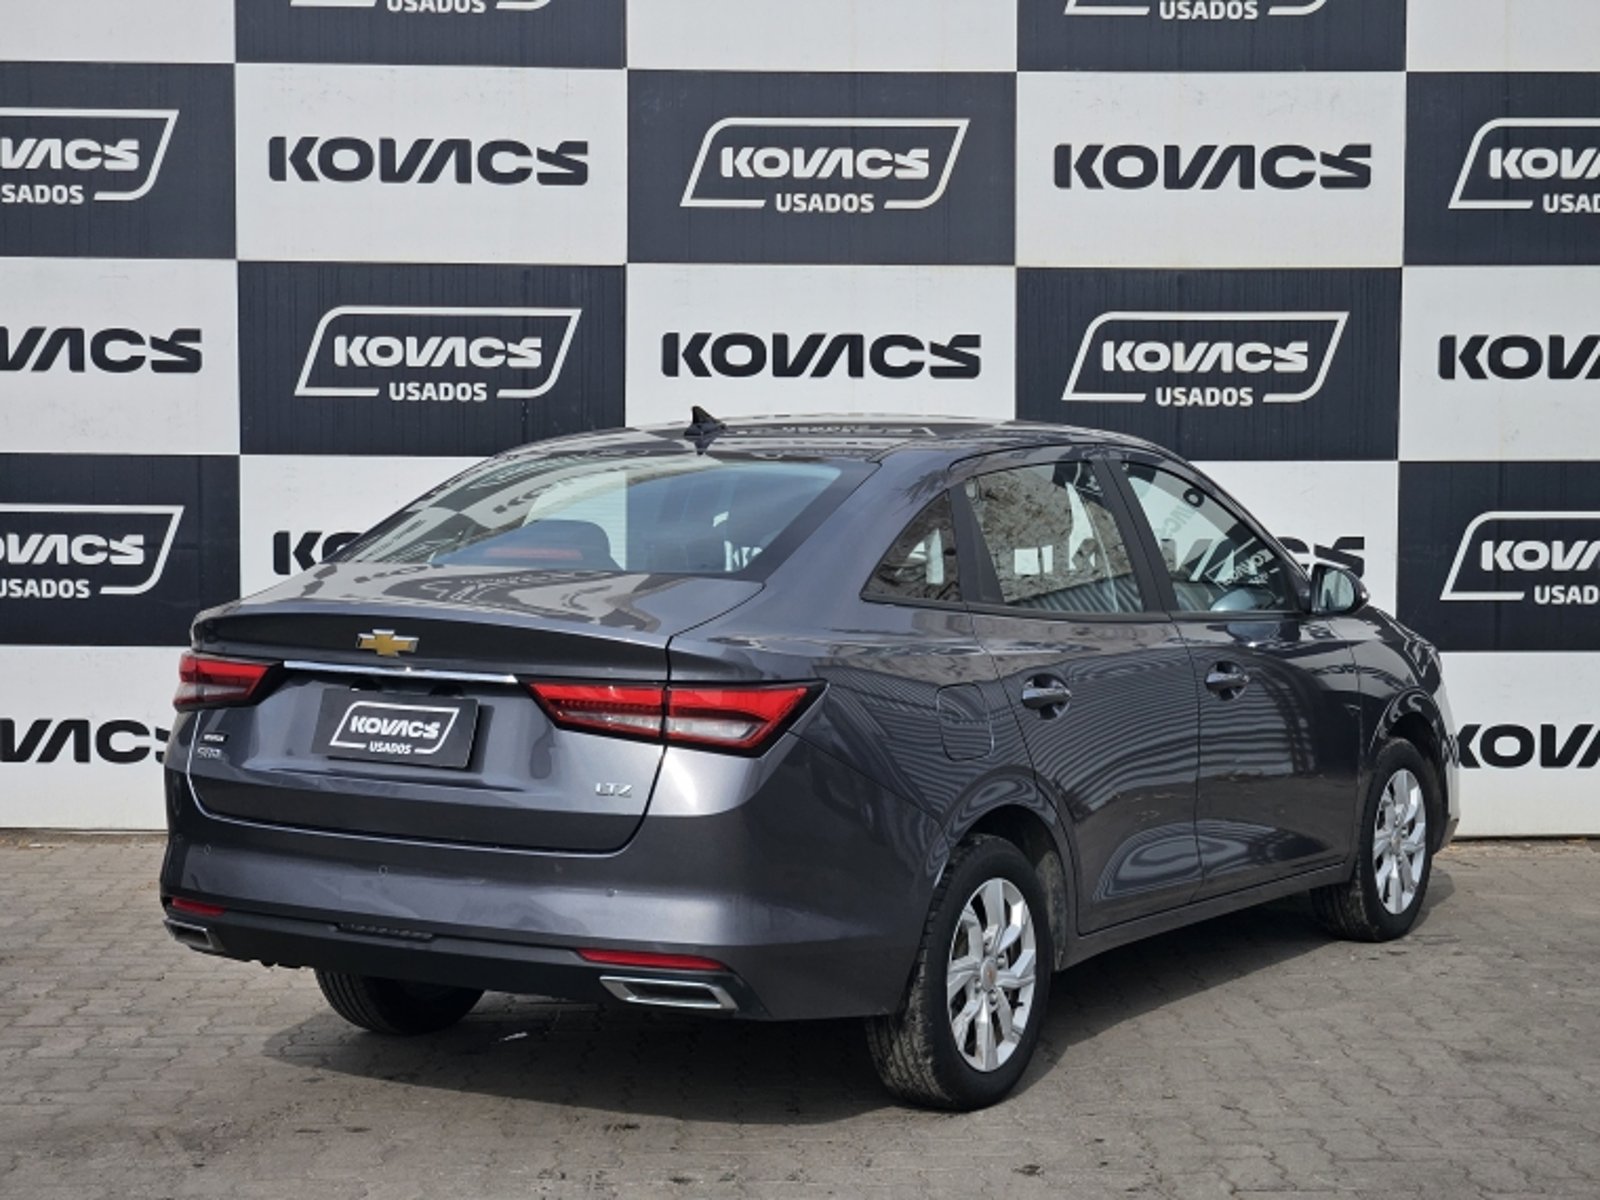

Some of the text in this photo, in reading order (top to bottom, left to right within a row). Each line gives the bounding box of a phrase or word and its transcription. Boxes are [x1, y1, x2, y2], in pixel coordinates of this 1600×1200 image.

[387, 0, 486, 13] USADOS
[1160, 0, 1258, 19] USADOS
[269, 136, 588, 185] KOVACS
[721, 147, 930, 180] KOVACS
[1054, 143, 1371, 189] KOVACS
[775, 193, 874, 213] USADOS
[334, 336, 541, 368] KOVACS
[662, 333, 980, 379] KOVACS
[1102, 340, 1308, 372] KOVACS
[1439, 334, 1600, 379] KOV
[389, 382, 487, 402] USADOS
[1156, 386, 1253, 406] USADOS
[0, 534, 144, 565] VACS
[0, 718, 171, 764] VAC
[350, 715, 441, 739] KOVACS
[368, 741, 412, 755] USADOS
[595, 782, 632, 798] LTZ
